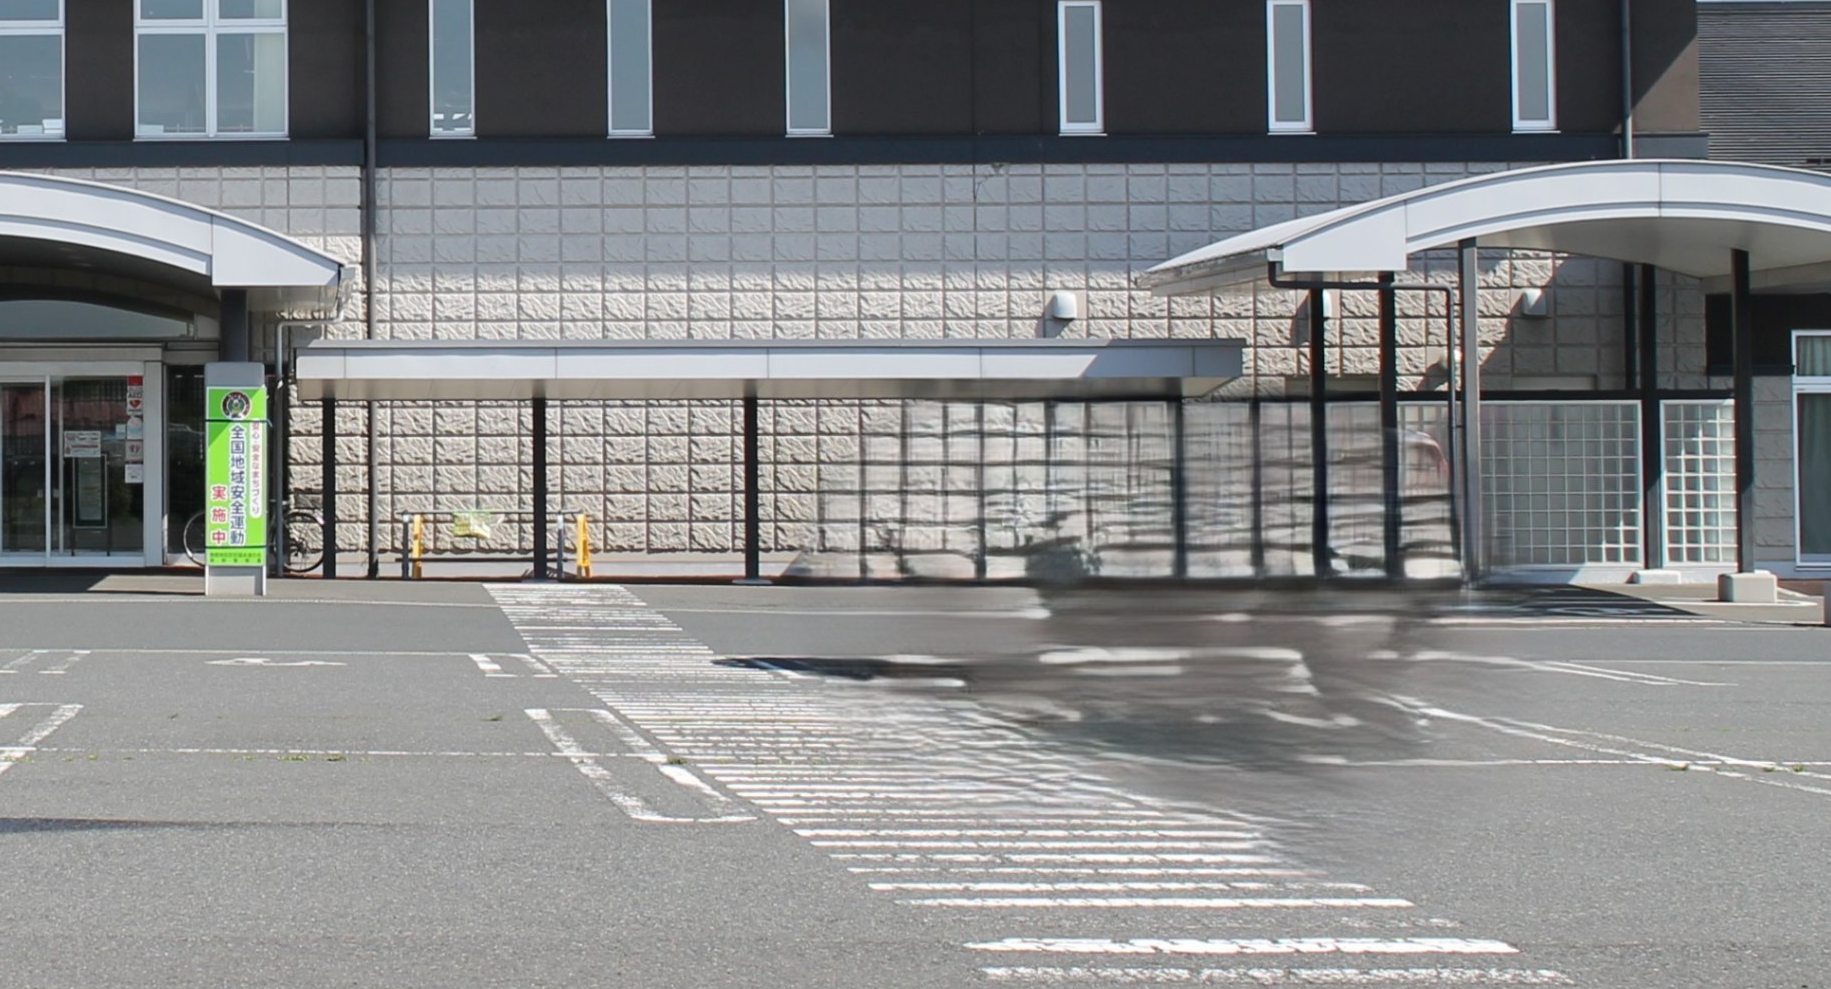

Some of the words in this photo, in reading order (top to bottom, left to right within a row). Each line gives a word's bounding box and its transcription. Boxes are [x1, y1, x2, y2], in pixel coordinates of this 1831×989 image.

[212, 486, 226, 544] 実施中
[231, 425, 245, 544] 全国地域安全運動
